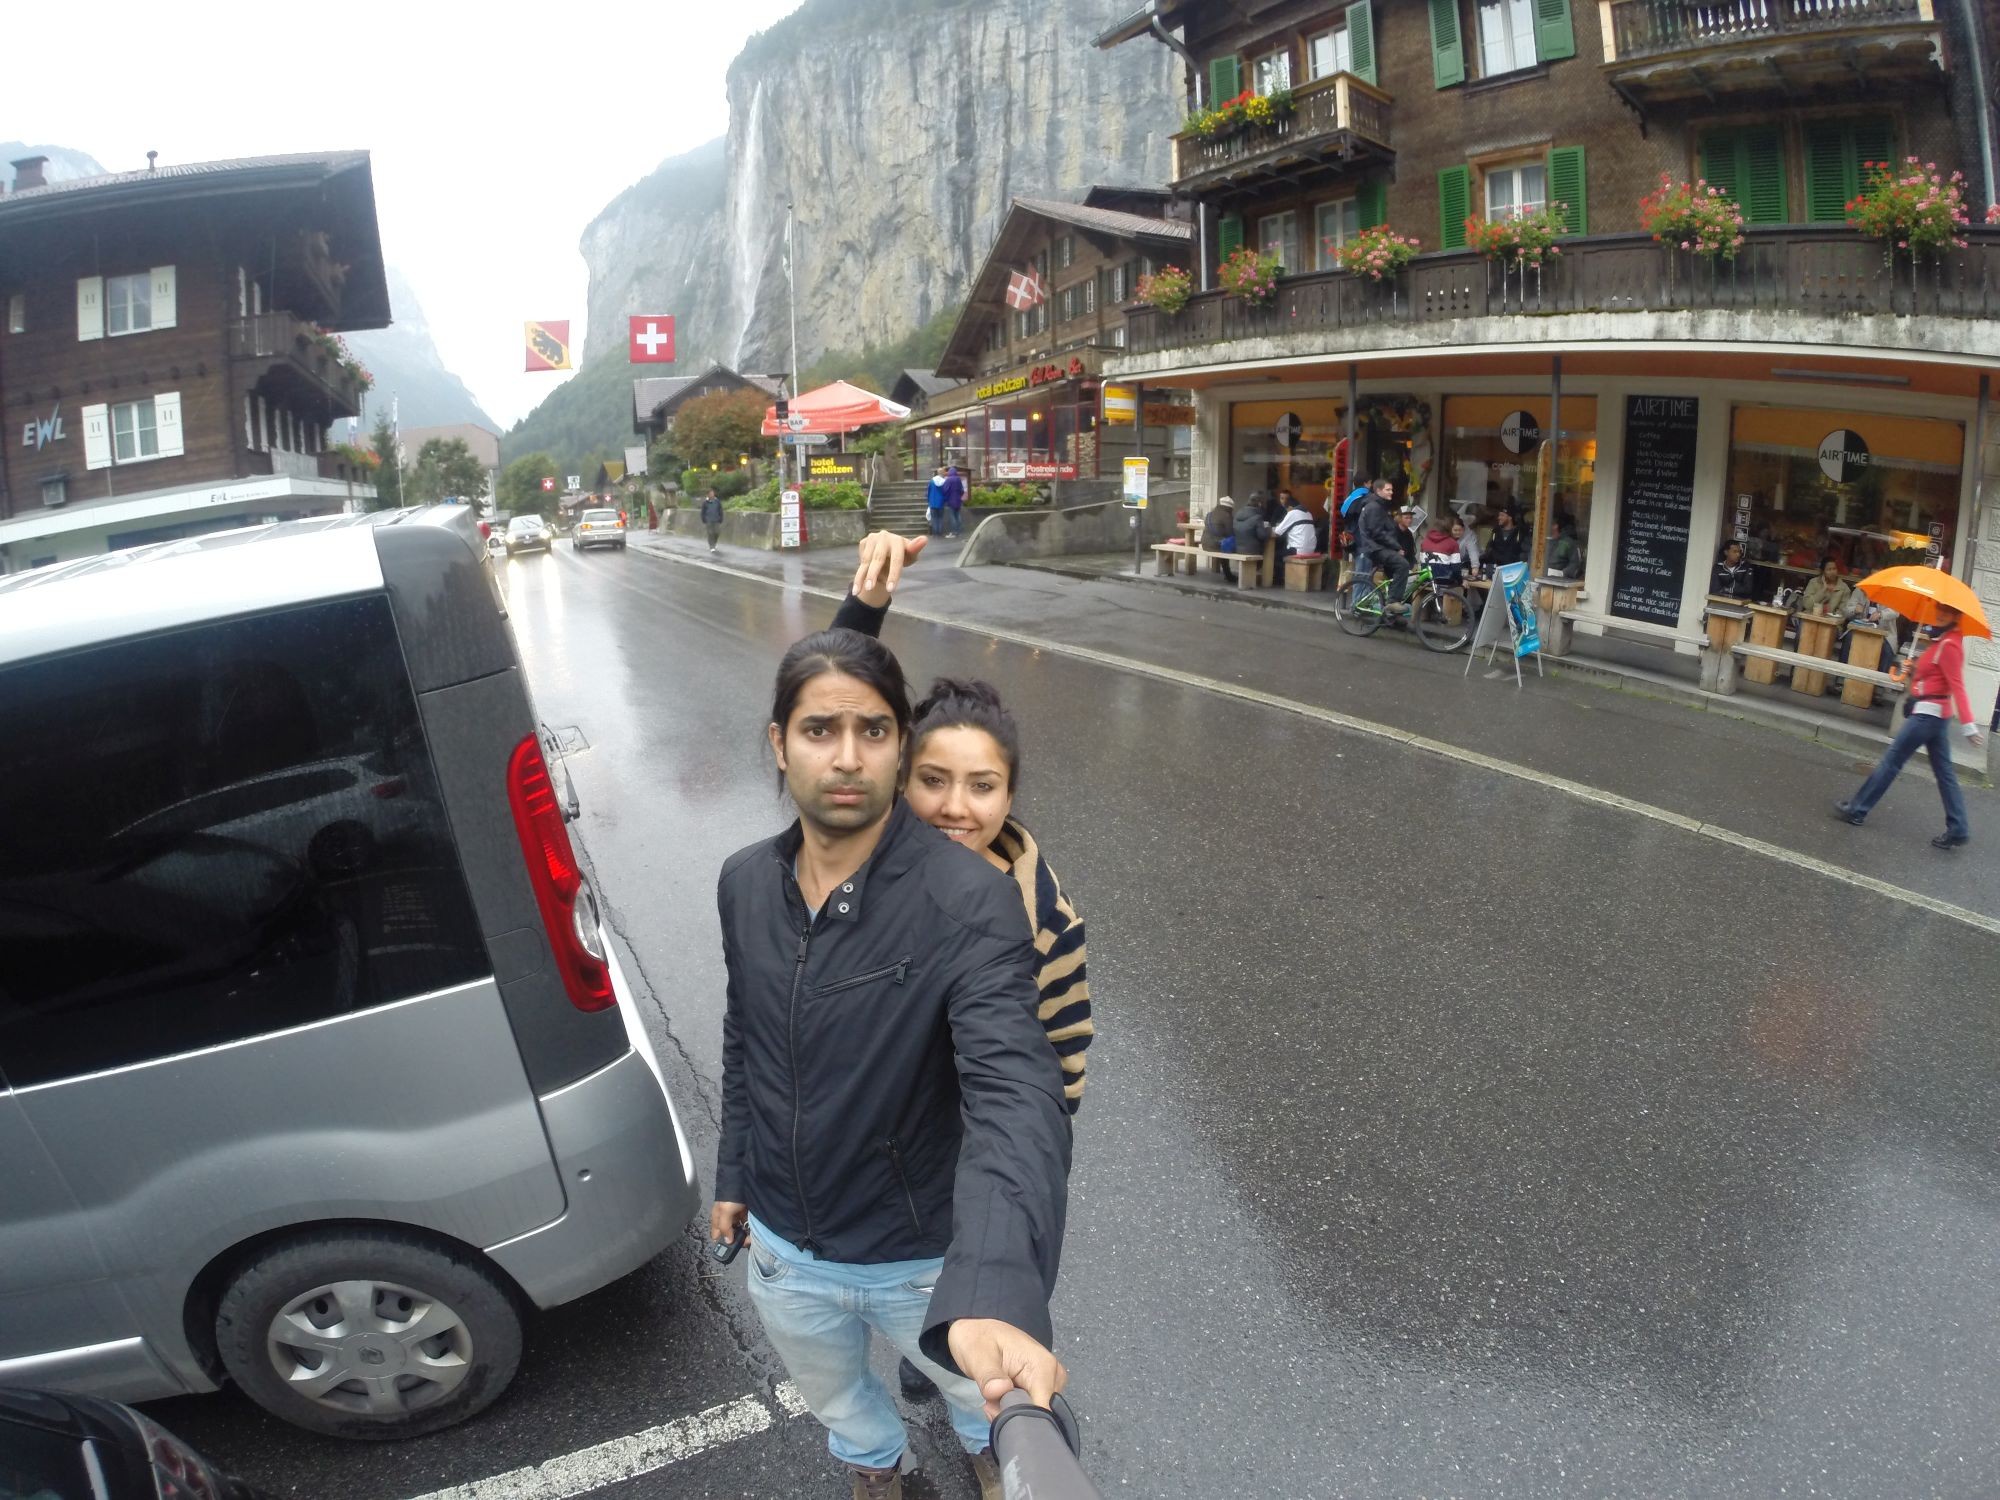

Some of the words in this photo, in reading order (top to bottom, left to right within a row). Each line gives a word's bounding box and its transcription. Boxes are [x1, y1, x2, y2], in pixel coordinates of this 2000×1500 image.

[993, 377, 1026, 395] schützen
[1633, 398, 1695, 416] AIRTIME
[22, 402, 66, 451] EWL
[1502, 428, 1540, 441] AIRTIME
[810, 457, 834, 466] hotel
[1820, 449, 1869, 465] AIRTIME
[810, 465, 853, 475] schützen
[1492, 461, 1521, 473] coffee
[1523, 464, 1537, 474] tim
[1629, 537, 1648, 546] Soup
[1627, 546, 1650, 555] Quiche
[1627, 554, 1664, 566] BROWNIES
[1626, 563, 1649, 574] Cookies
[1629, 585, 1645, 594] AND
